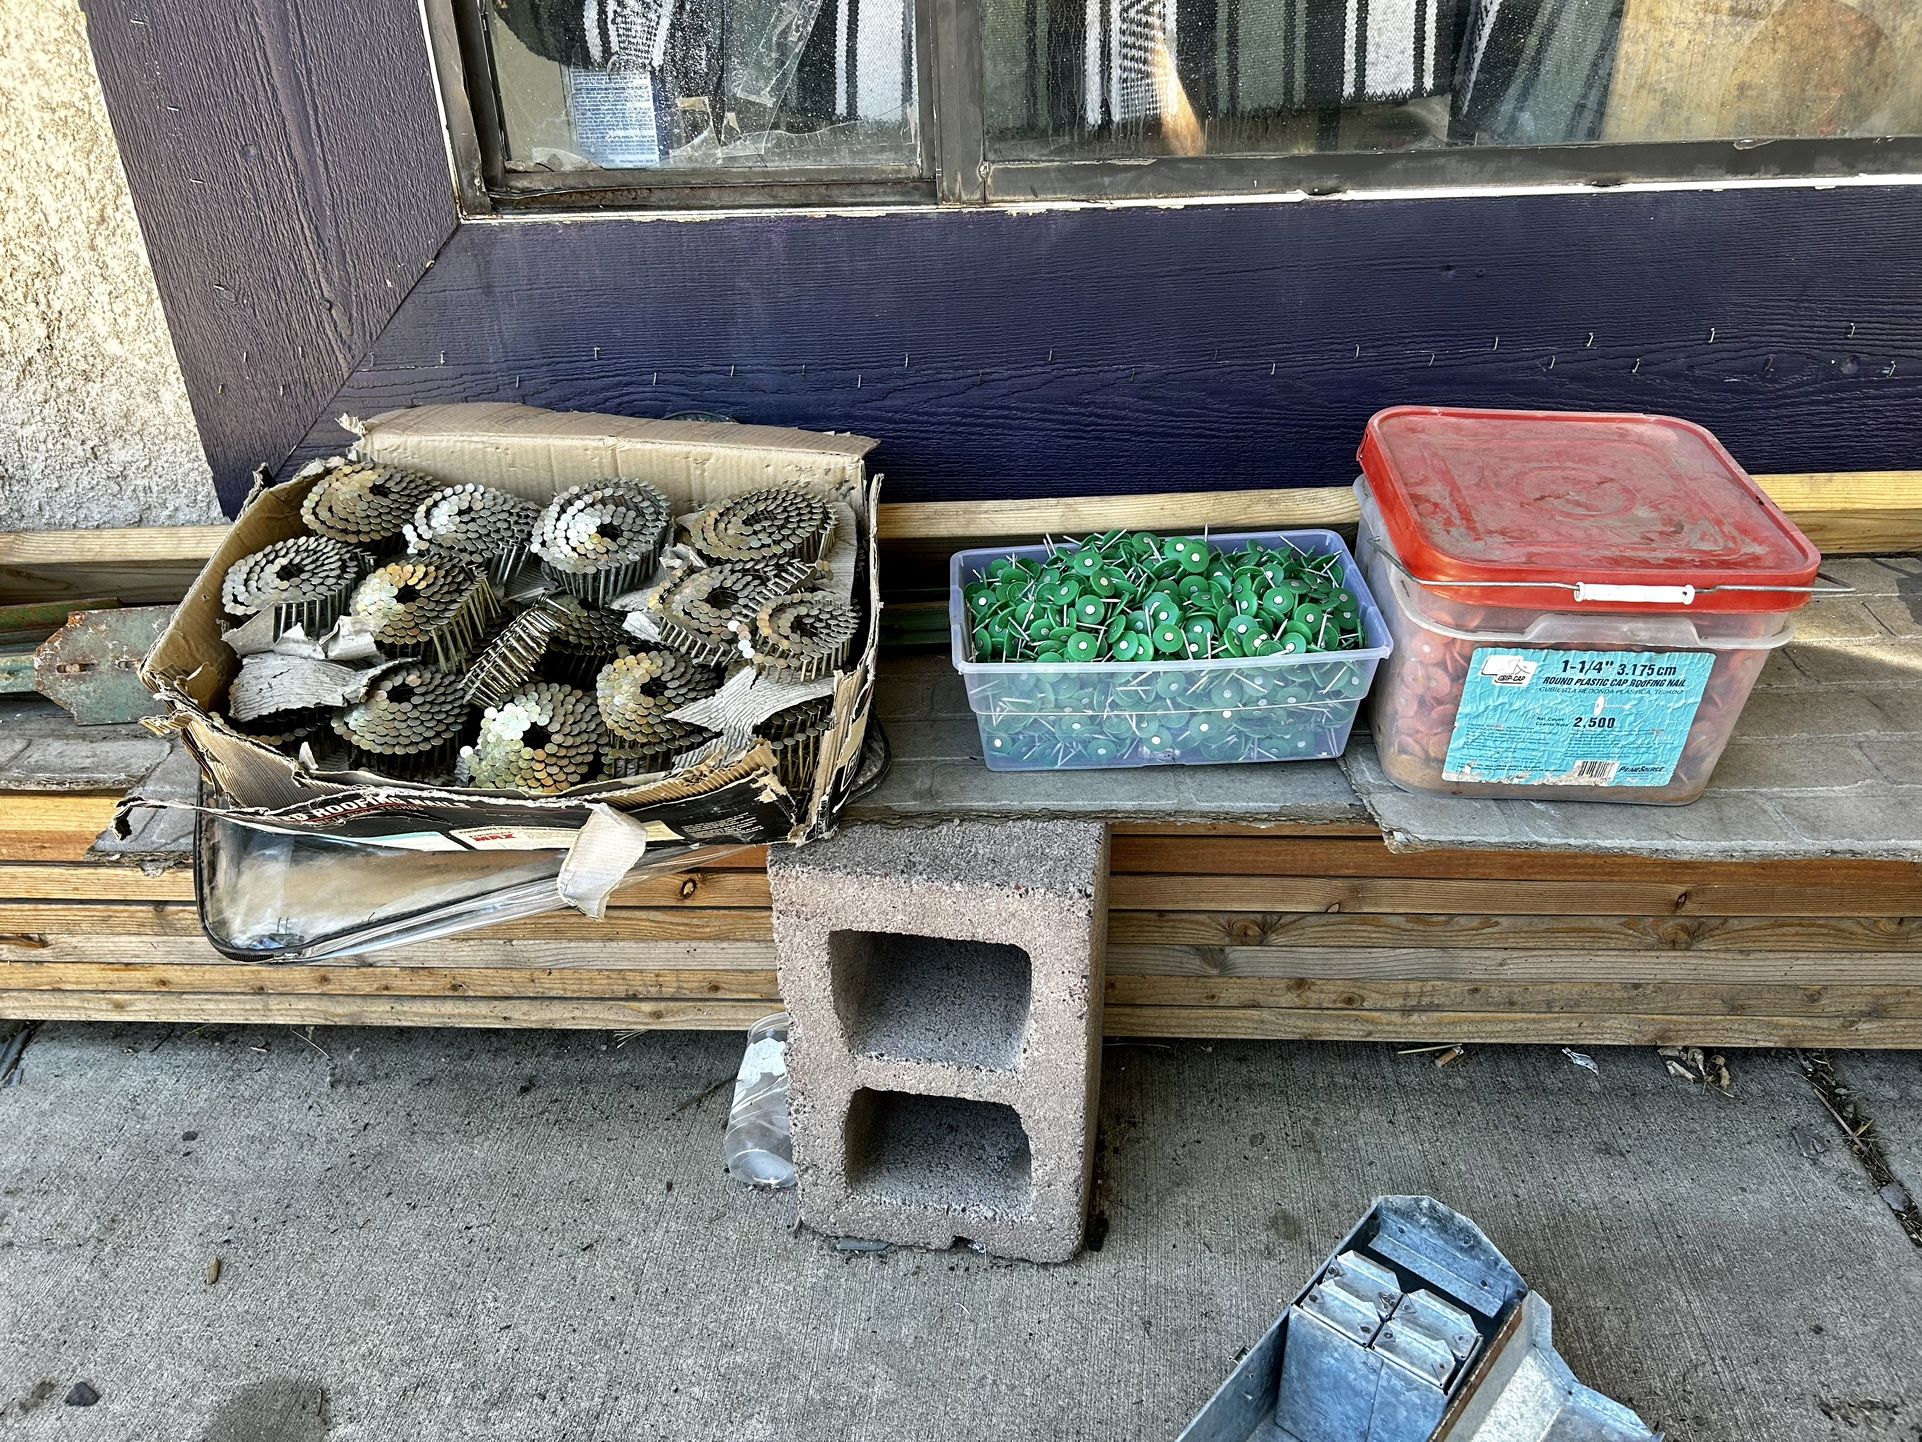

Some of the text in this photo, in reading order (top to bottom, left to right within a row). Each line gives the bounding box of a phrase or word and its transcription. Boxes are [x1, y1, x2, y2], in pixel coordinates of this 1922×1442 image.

[1561, 659, 1677, 676] 1-1/4" 3.175 cm
[1542, 676, 1687, 688] ROUND PLASTIC CAP ROOFING NAIL
[1573, 716, 1616, 729] 2,500
